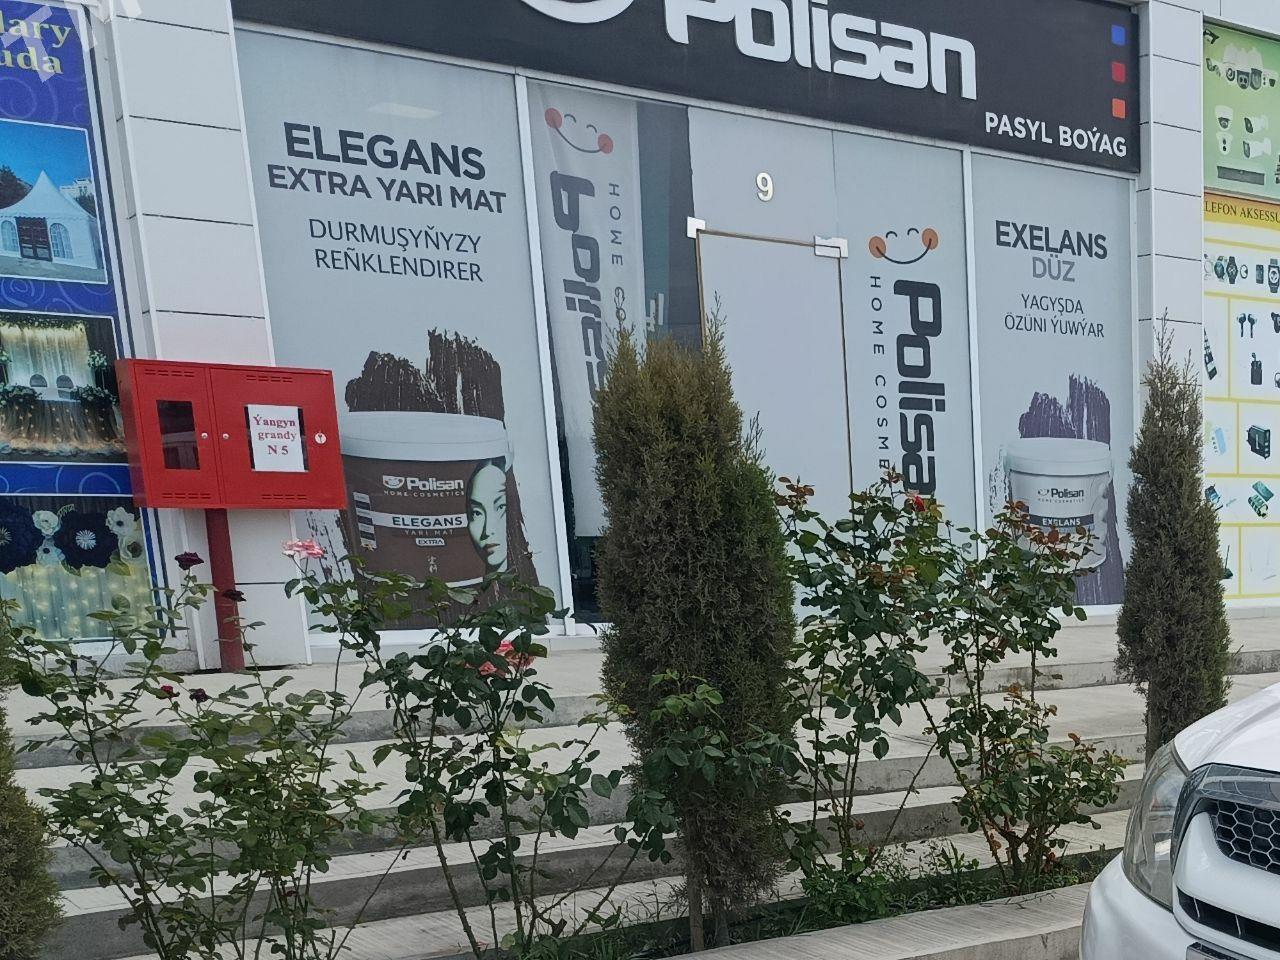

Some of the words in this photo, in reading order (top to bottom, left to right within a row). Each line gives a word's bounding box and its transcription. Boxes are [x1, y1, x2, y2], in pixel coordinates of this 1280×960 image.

[664, 0, 977, 99] Polisan
[985, 111, 1053, 145] PASYL
[1058, 123, 1127, 158] BOÝAG
[284, 121, 486, 180] ELEGANS
[267, 164, 372, 199] EXTRA
[376, 177, 443, 207] YARI
[450, 186, 507, 214] MAT
[755, 172, 774, 202] 9
[995, 220, 1108, 260] EXELANS
[1032, 253, 1075, 282] DÜZ
[870, 275, 885, 354] HOME
[1021, 293, 1084, 316] YAGYŞDA
[1004, 312, 1047, 332] ÖZÜNI
[893, 279, 946, 497] Polisa
[258, 430, 297, 442] grandy
[875, 374, 890, 468] COSME
[267, 445, 278, 455] N
[281, 445, 289, 455] 5
[406, 477, 465, 491] Polisan
[1050, 488, 1084, 499] Polisan
[392, 516, 463, 527] ELEGANS
